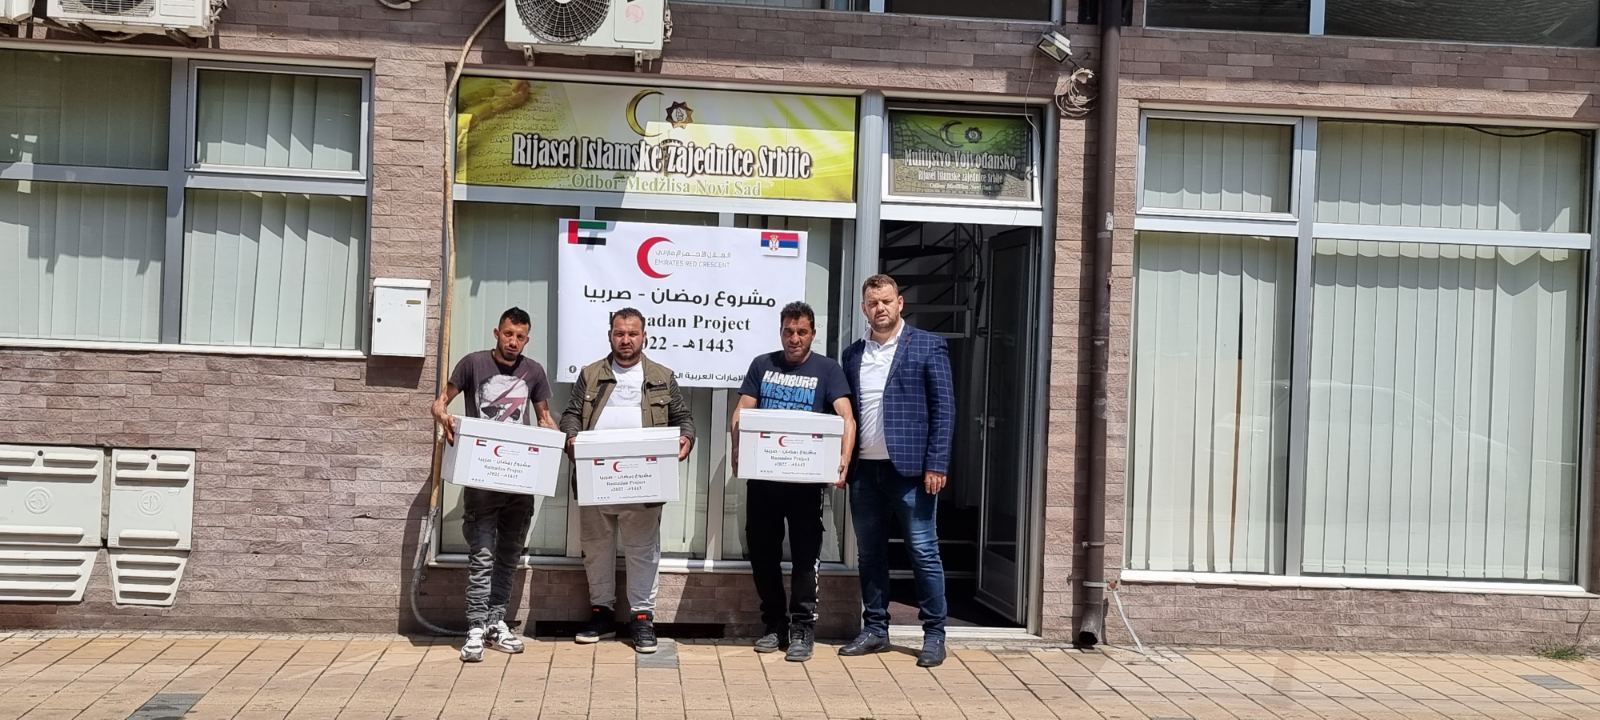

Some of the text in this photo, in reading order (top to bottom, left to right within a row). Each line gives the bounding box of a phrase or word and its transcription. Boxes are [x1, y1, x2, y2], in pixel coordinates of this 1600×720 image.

[512, 133, 577, 170] Rijaset
[580, 136, 662, 172] Islamske
[758, 145, 812, 179] Srbije
[571, 172, 622, 190] Odbor
[626, 174, 690, 193] Medžlisa
[696, 179, 729, 195] Novi
[734, 181, 761, 196] Sad
[583, 284, 632, 303] صربيا
[651, 288, 709, 306] رمضان
[714, 289, 776, 308] مشروع
[693, 315, 751, 333] Project
[762, 369, 819, 390] HAMBURG
[760, 382, 816, 405] MISSION
